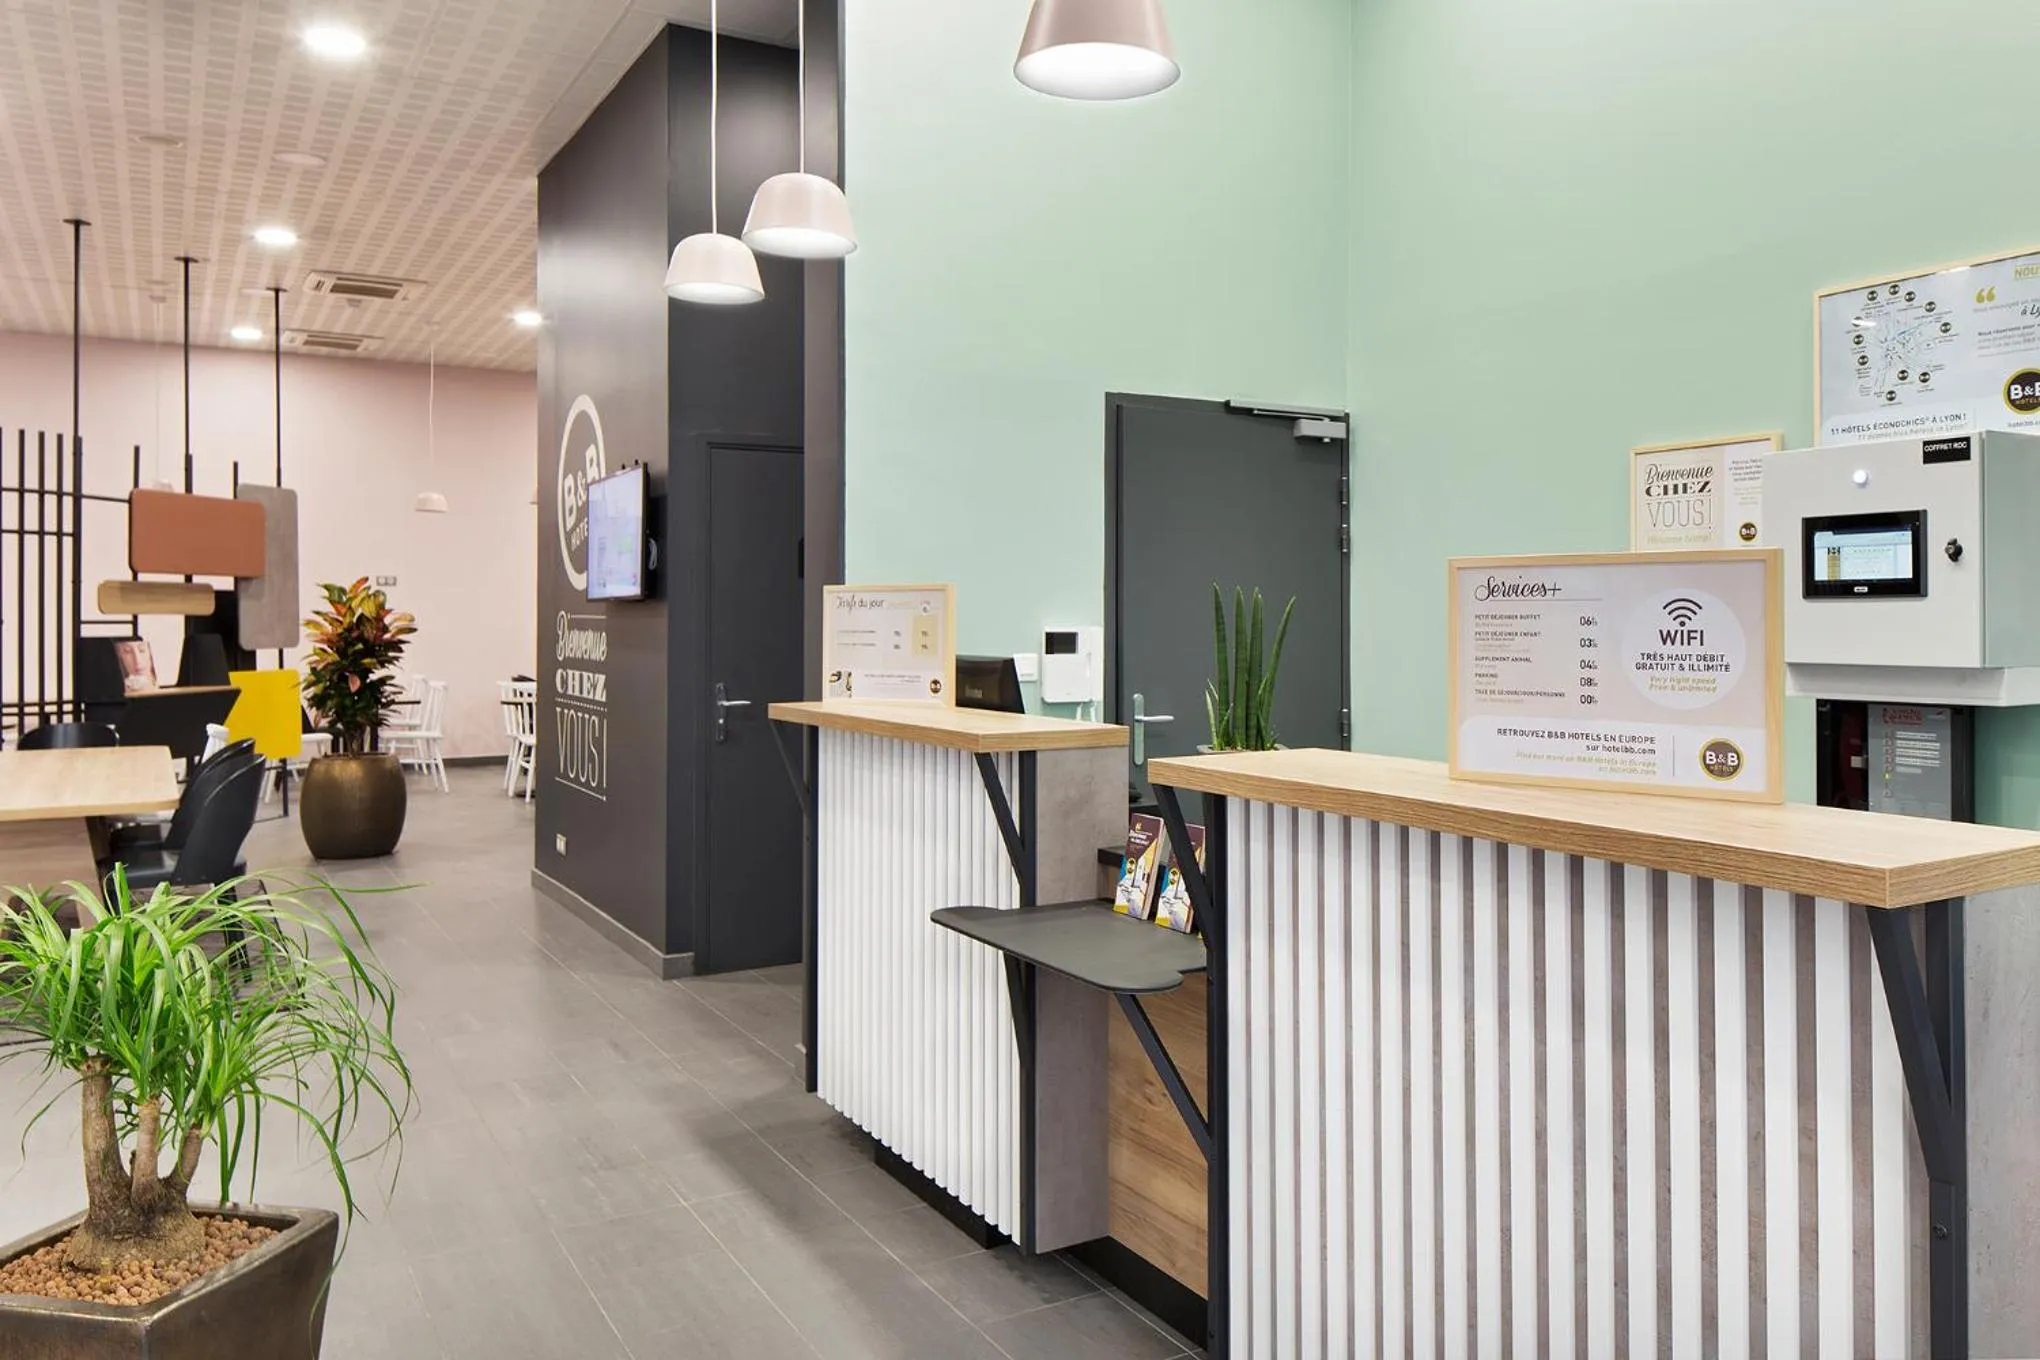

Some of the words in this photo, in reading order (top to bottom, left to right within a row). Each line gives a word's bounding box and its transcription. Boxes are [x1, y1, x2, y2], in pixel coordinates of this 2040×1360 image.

[2029, 304, 2040, 318] Ly
[1646, 463, 1714, 485] Bienvenue
[1645, 480, 1712, 497] CHEZ
[1474, 575, 1562, 601] Services+
[556, 610, 608, 662] Bienvenue
[1666, 653, 1692, 662] HAUT
[1695, 652, 1725, 662] DÉBIT
[1635, 662, 1675, 671] GRATUIT
[1678, 663, 1685, 672] &
[1688, 662, 1730, 672] ILLIMITÉ
[555, 668, 607, 702] CHEZ
[1496, 727, 1546, 739] RETROUVEZ
[1547, 730, 1566, 740] B&B
[1567, 731, 1602, 742] HOTELS
[1603, 734, 1616, 743] EN
[1618, 734, 1656, 745] EUROPE
[1601, 743, 1656, 755] hotelbb.com
[1705, 751, 1739, 766] B&B
